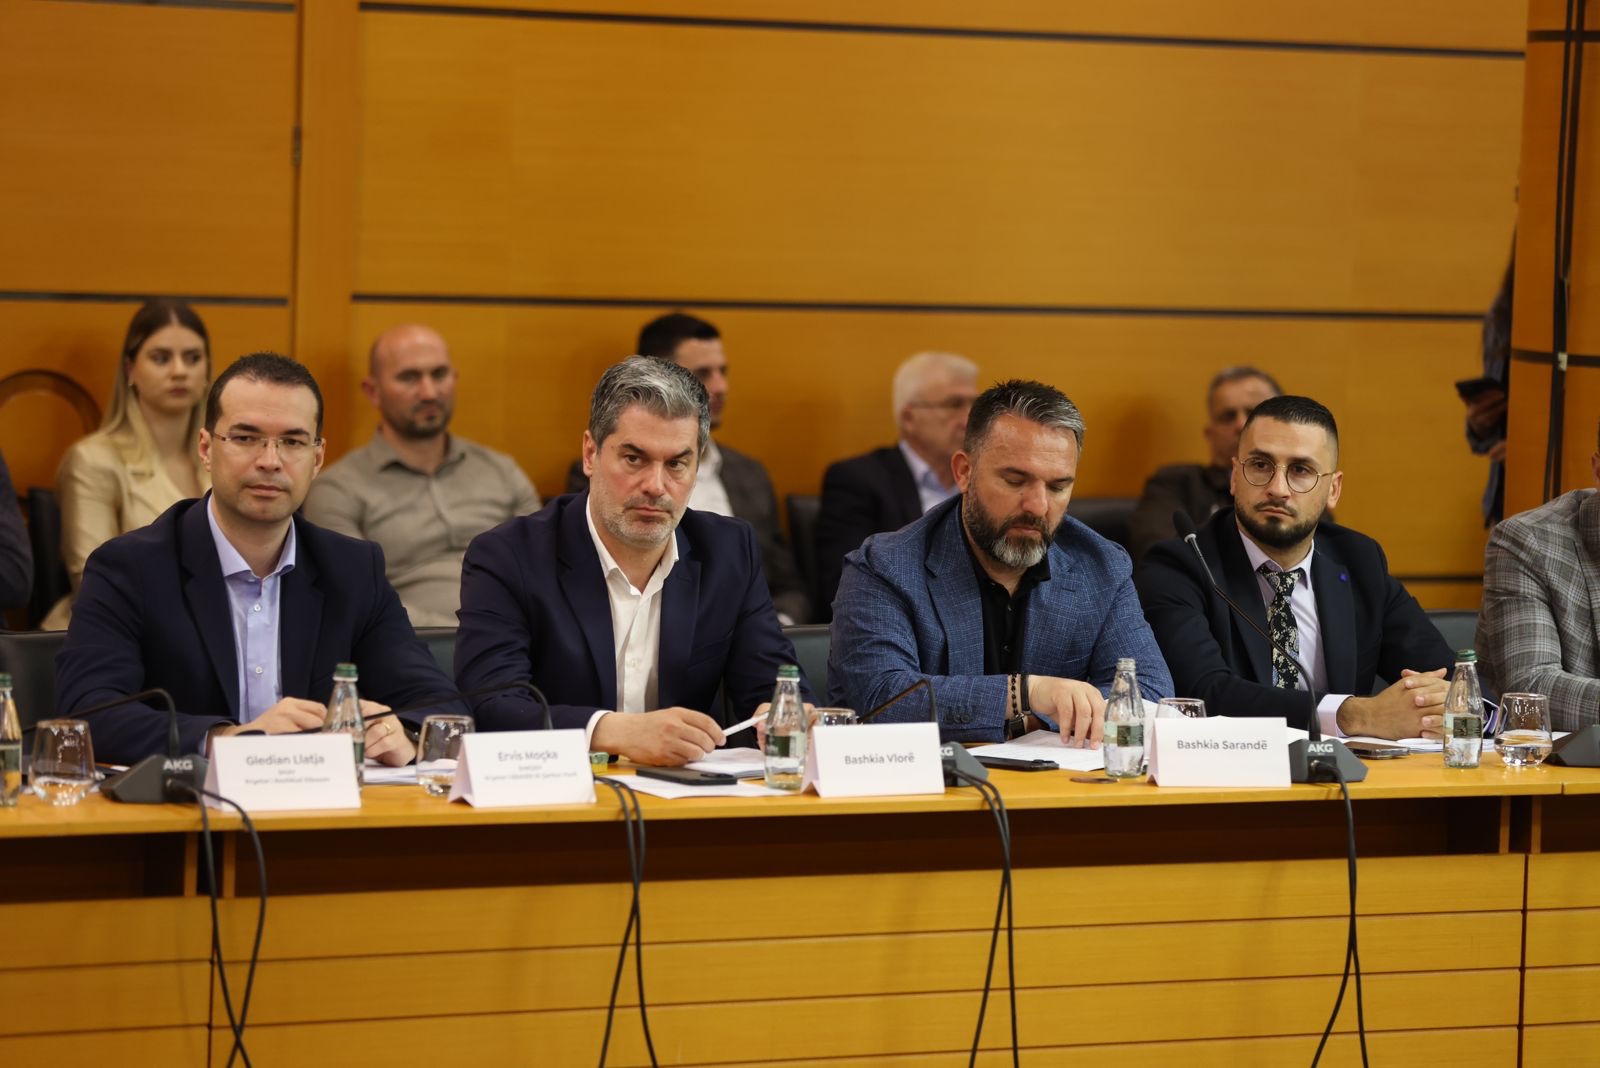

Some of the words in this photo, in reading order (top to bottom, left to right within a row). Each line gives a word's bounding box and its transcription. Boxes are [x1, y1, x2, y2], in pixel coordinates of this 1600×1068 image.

[1177, 739, 1219, 750] Bashkia
[1222, 739, 1268, 750] Sarandë
[1307, 743, 1334, 753] AKG
[246, 755, 291, 766] Gledian
[498, 751, 522, 762] Ervis
[844, 753, 885, 765] Bashkia
[886, 752, 915, 764] Vlorë
[163, 759, 194, 770] AKG
